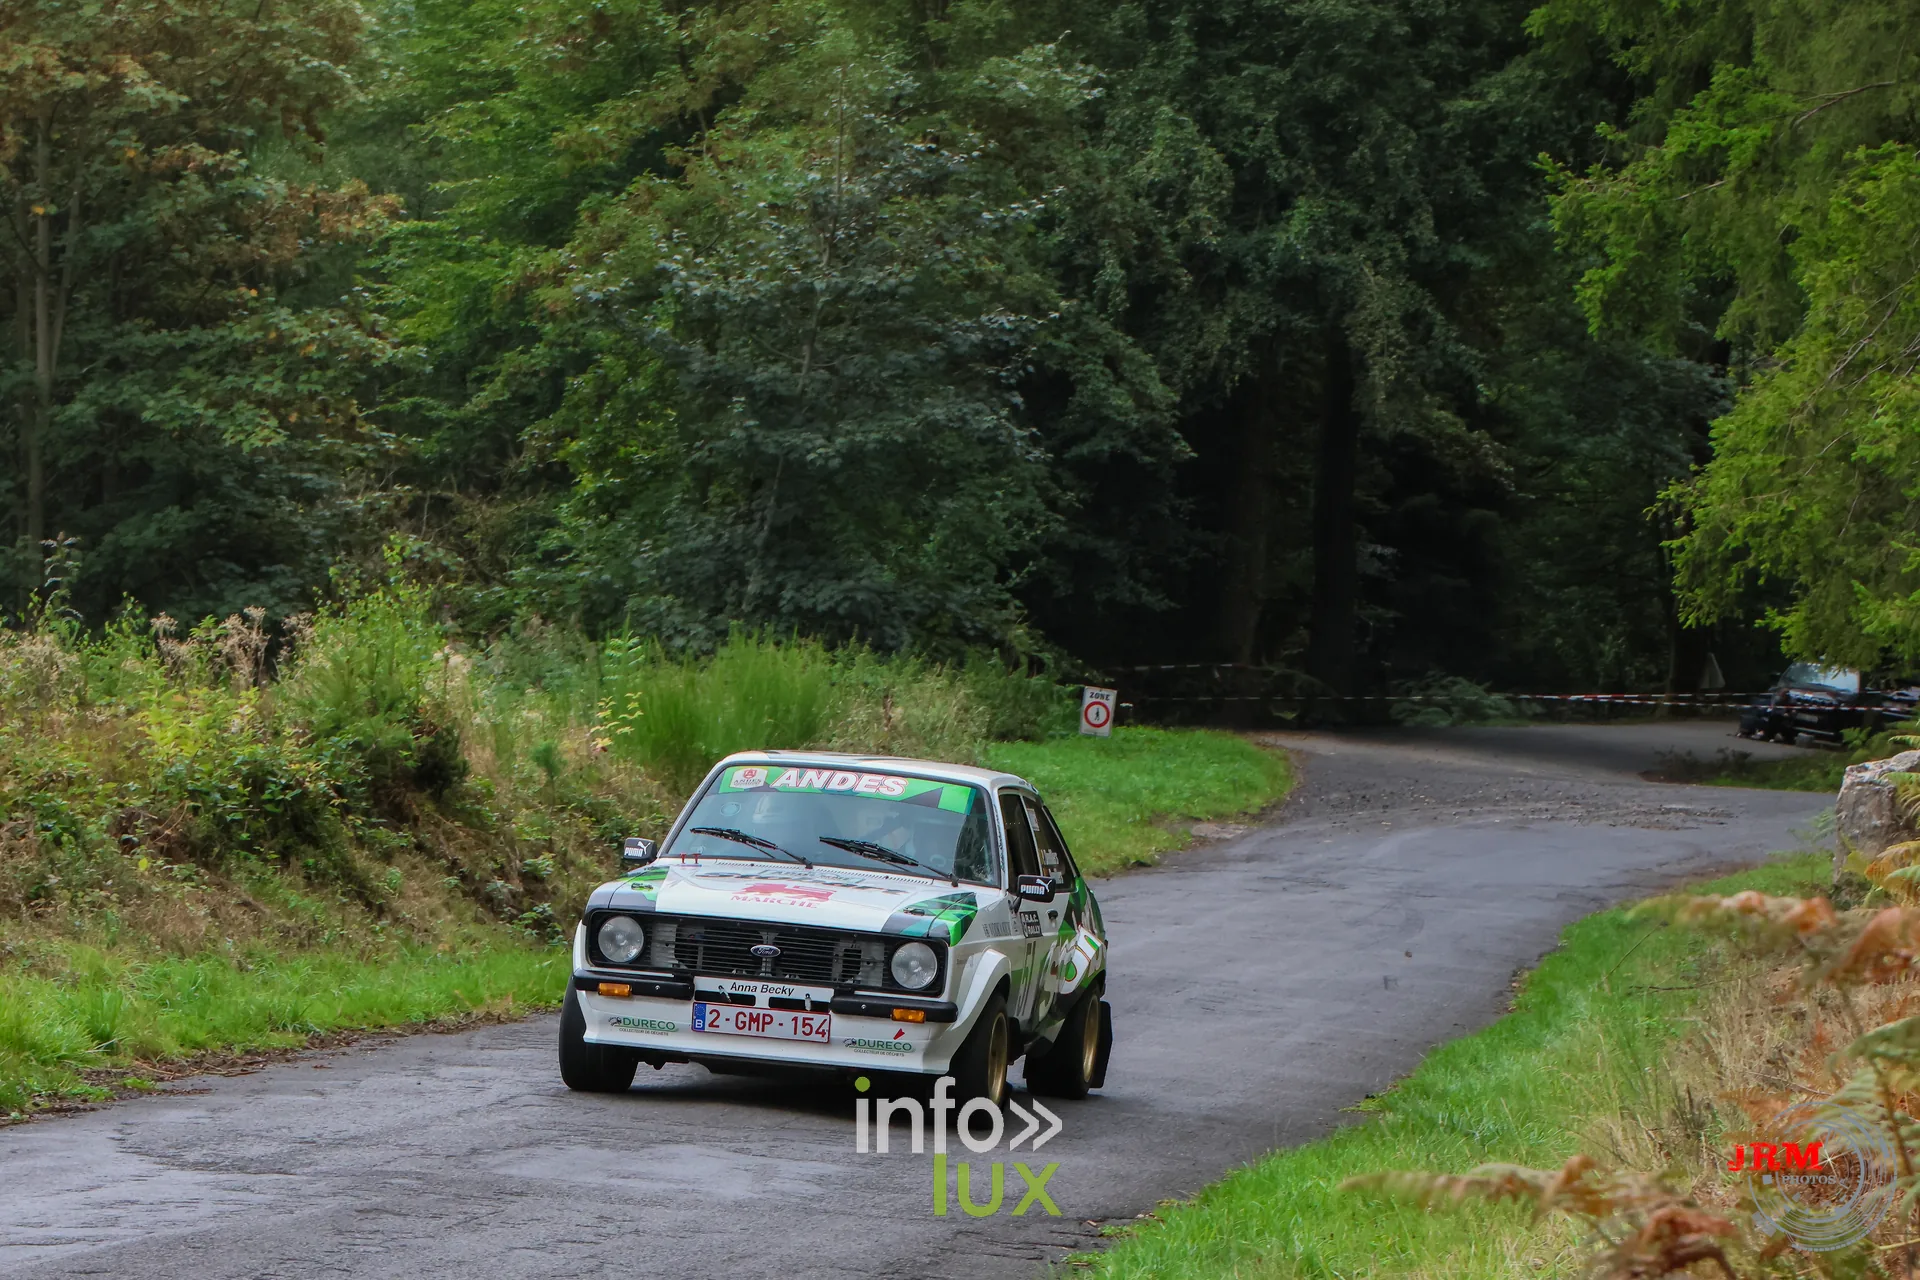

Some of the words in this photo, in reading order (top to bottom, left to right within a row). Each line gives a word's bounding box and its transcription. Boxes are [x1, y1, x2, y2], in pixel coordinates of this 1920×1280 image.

[1087, 690, 1111, 702] ZONE
[770, 768, 908, 797] ANDES
[1020, 884, 1045, 895] PUMA
[731, 895, 821, 909] MARCHE
[730, 982, 757, 993] Anna
[761, 984, 795, 997] Becky
[622, 1017, 676, 1031] DURECO
[695, 1020, 704, 1029] B
[858, 1038, 912, 1051] DURECO
